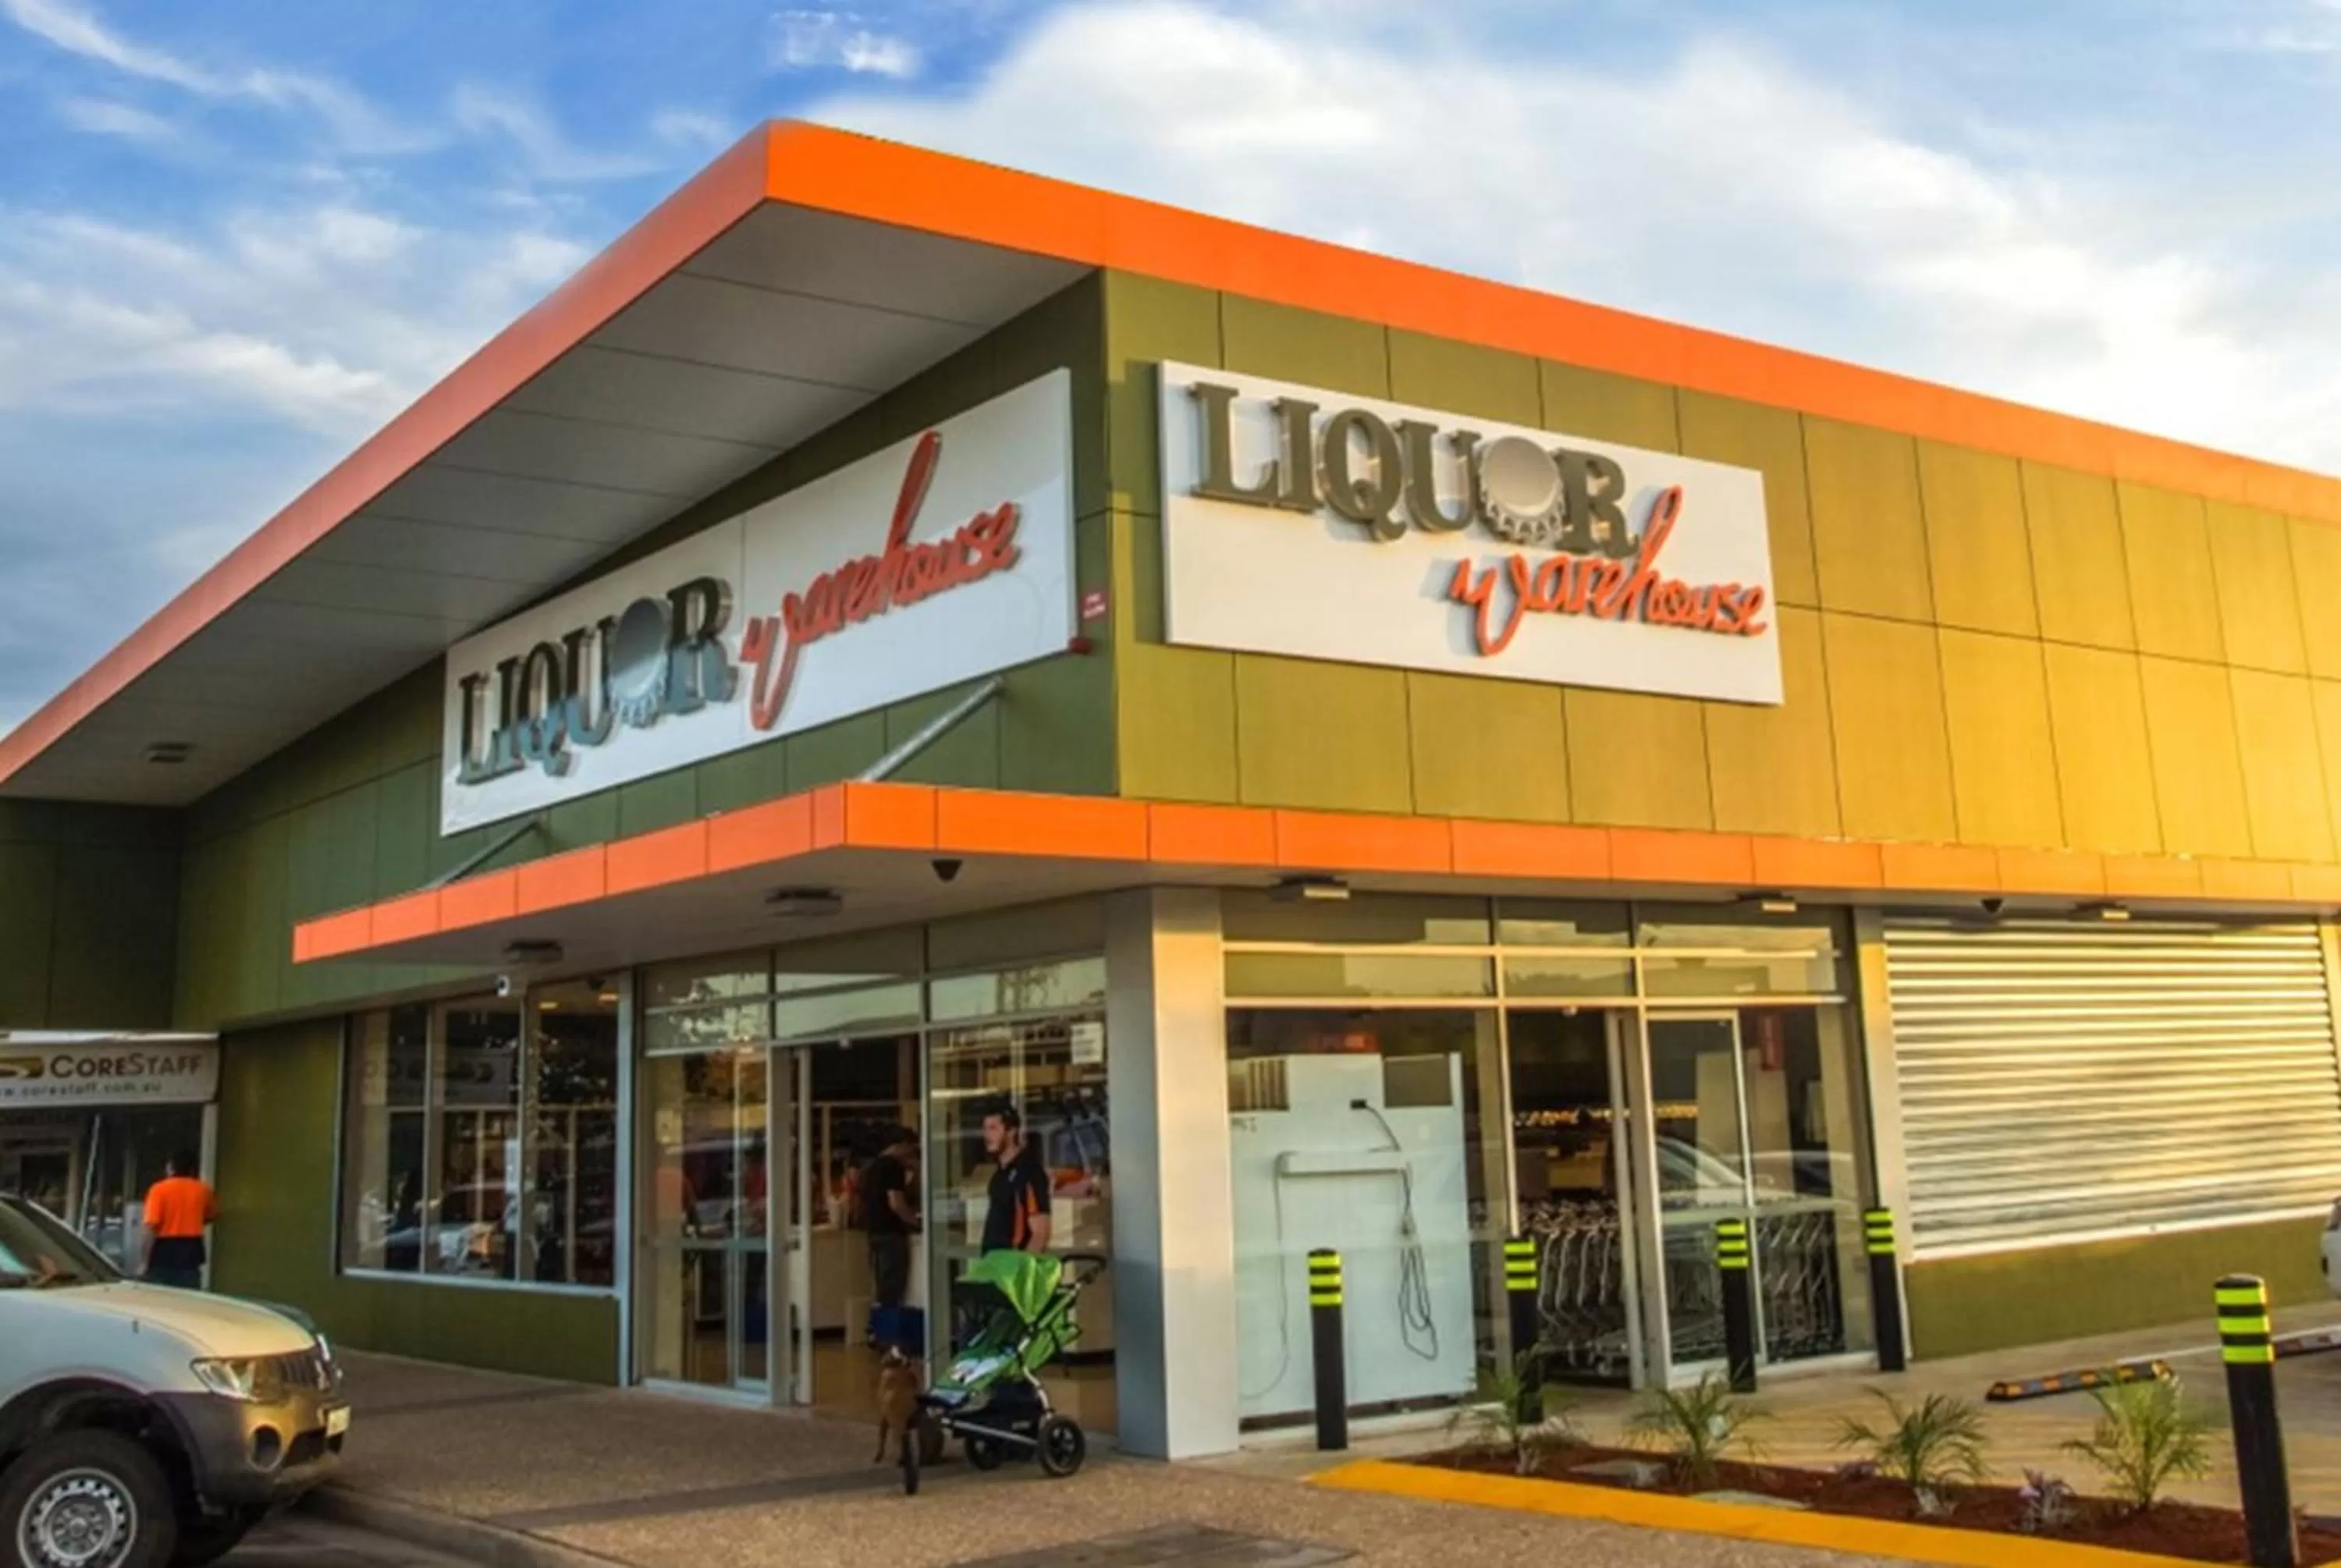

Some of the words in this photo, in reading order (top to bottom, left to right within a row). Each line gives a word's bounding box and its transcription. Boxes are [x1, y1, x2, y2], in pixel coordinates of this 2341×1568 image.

[1189, 381, 1639, 558] LIQUOR
[456, 574, 741, 785] LIQUOR
[50, 1052, 201, 1079] CORESTAFF
